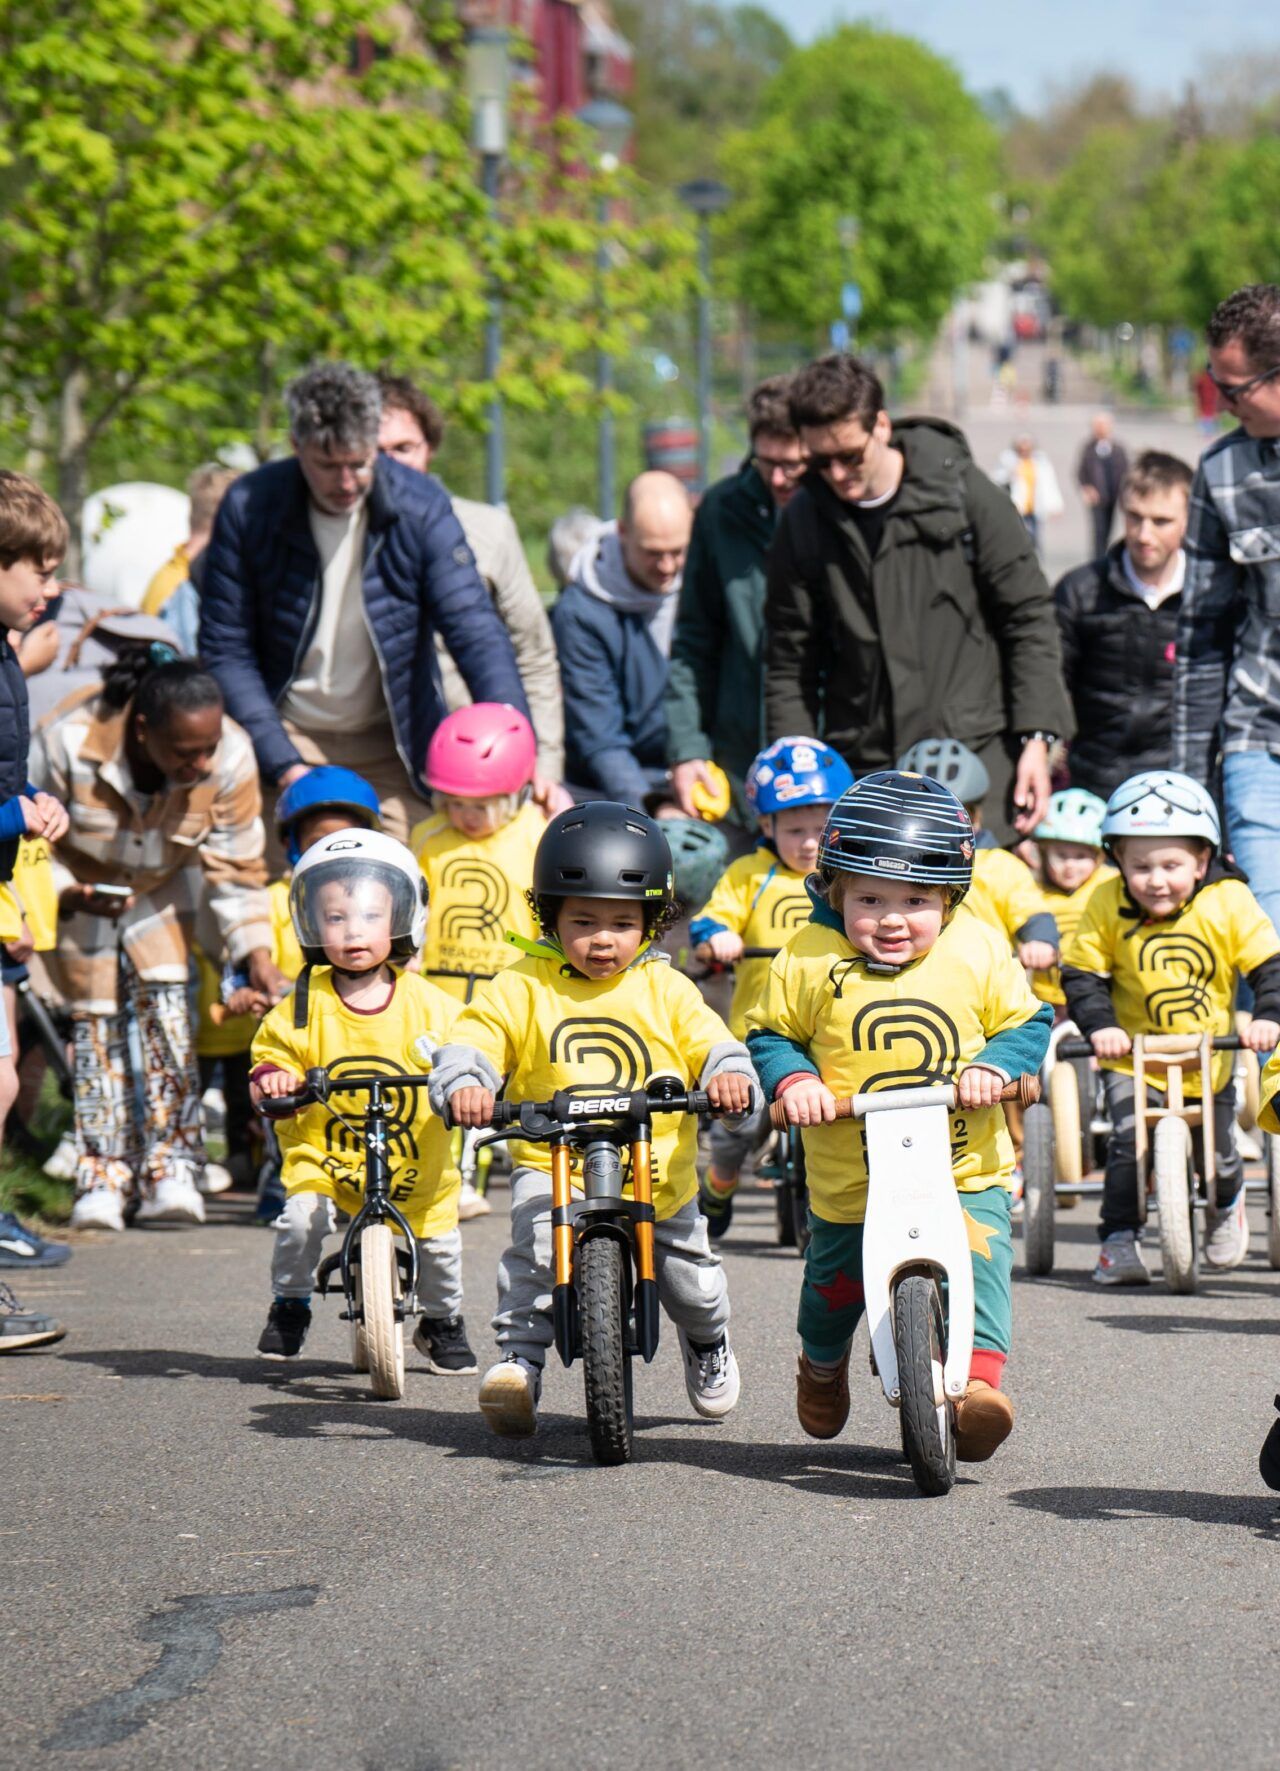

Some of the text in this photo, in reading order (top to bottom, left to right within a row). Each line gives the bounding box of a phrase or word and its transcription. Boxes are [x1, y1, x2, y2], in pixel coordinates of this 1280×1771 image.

[568, 1098, 631, 1114] BERG
[953, 1118, 968, 1137] 2
[403, 1168, 418, 1184] 2
